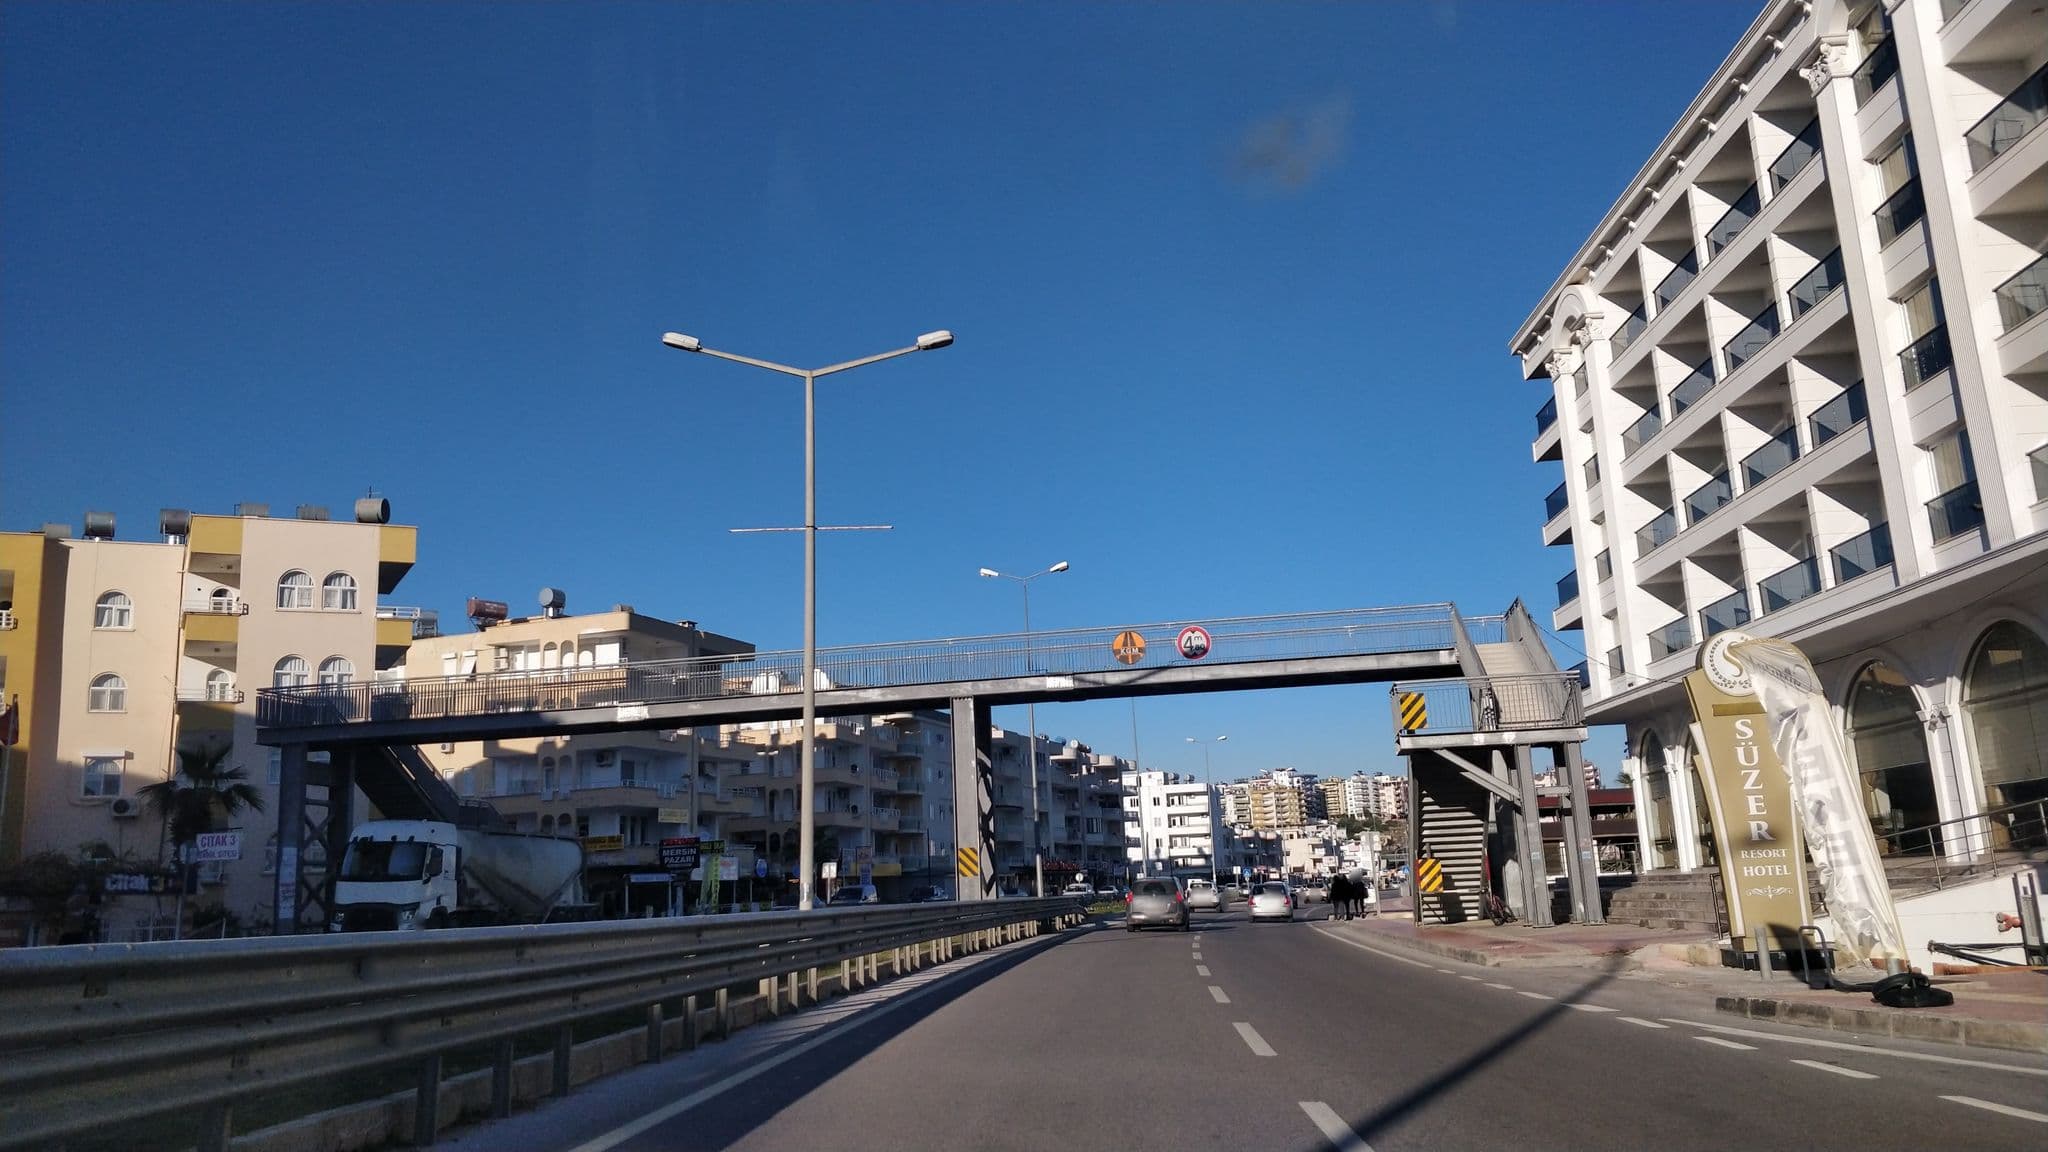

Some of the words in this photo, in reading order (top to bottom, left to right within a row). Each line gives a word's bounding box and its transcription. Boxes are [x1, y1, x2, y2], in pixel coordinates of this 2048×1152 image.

[1120, 647, 1139, 656] KGM
[1735, 718, 1777, 841] SÜZER
[1741, 848, 1788, 859] RESORT
[1743, 864, 1792, 877] HOTEL
